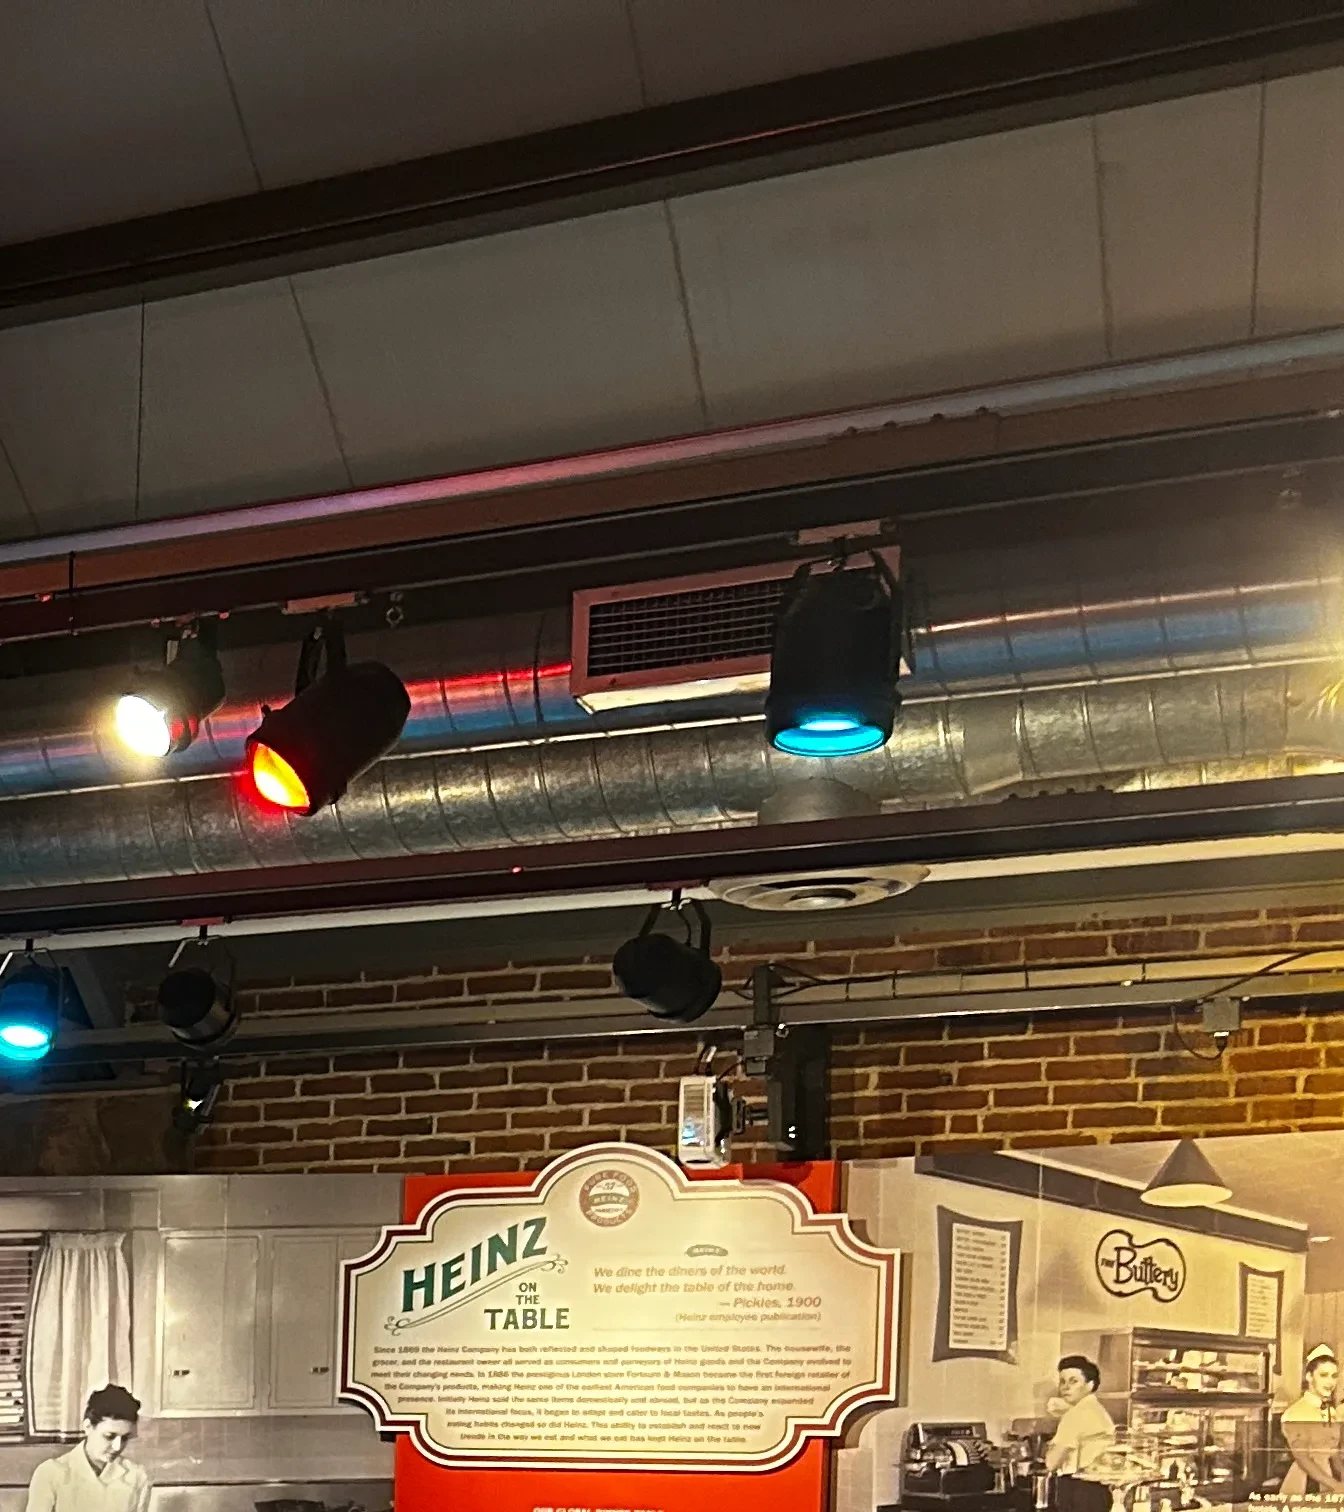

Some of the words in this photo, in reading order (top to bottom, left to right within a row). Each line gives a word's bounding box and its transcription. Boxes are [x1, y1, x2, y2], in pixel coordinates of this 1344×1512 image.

[402, 1217, 548, 1313] HEINZ
[594, 1267, 613, 1277] We
[645, 1266, 665, 1277] the
[725, 1265, 746, 1276] the
[1114, 1246, 1180, 1292] Buttery
[519, 1282, 537, 1293] ON
[594, 1283, 612, 1294] We
[660, 1282, 680, 1293] the
[718, 1281, 731, 1292] of
[734, 1281, 755, 1292] the
[515, 1295, 540, 1305] THE
[787, 1296, 822, 1308] 1900
[484, 1308, 570, 1330] TABLE
